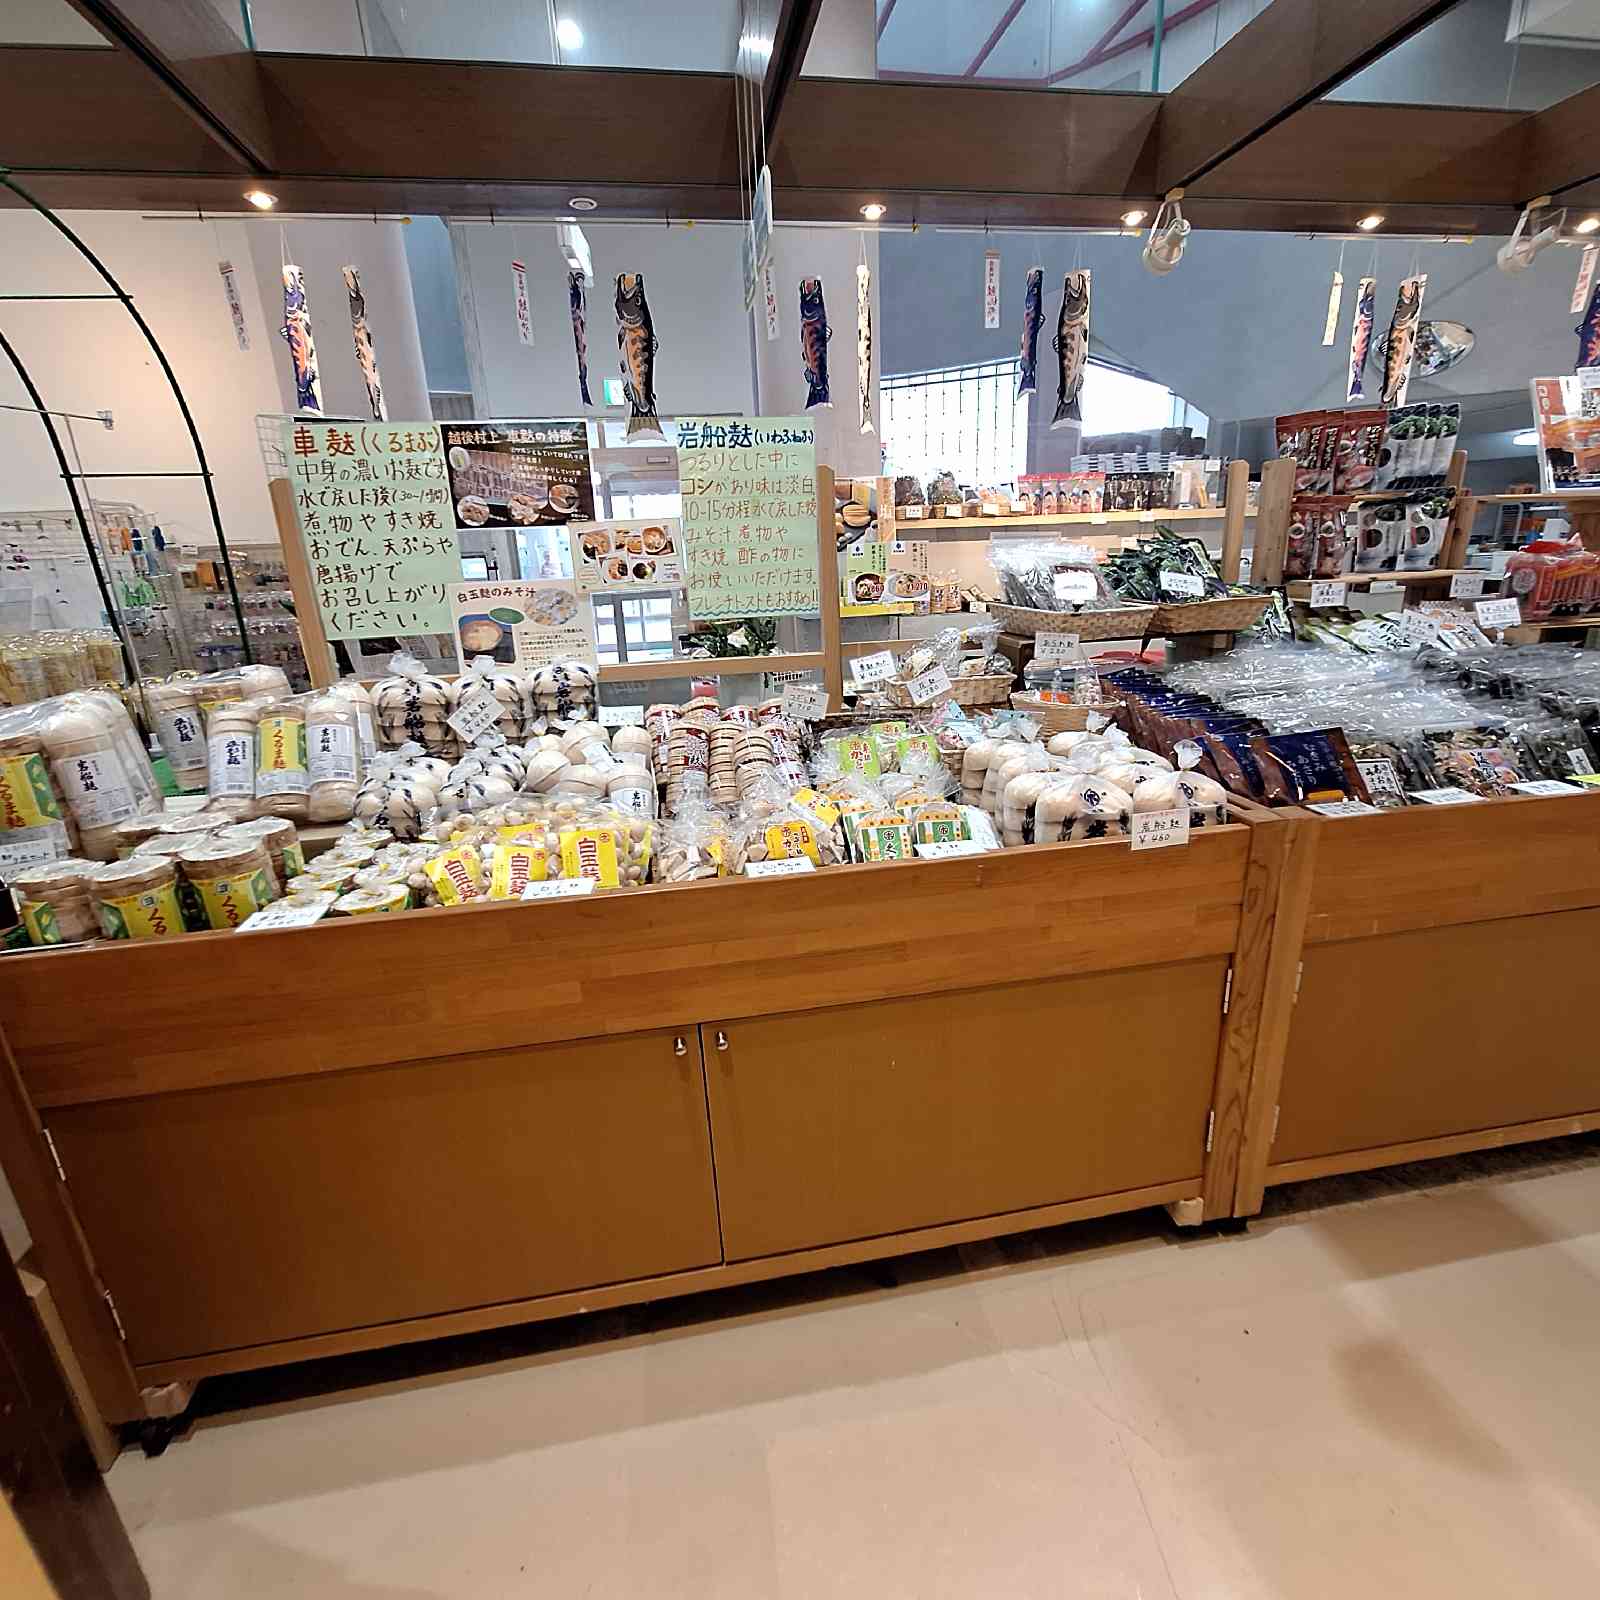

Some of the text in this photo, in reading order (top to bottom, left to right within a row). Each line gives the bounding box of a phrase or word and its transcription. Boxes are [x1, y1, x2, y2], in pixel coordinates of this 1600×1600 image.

[317, 561, 403, 585] 唐揚げで
[319, 583, 447, 608] お召し上がり
